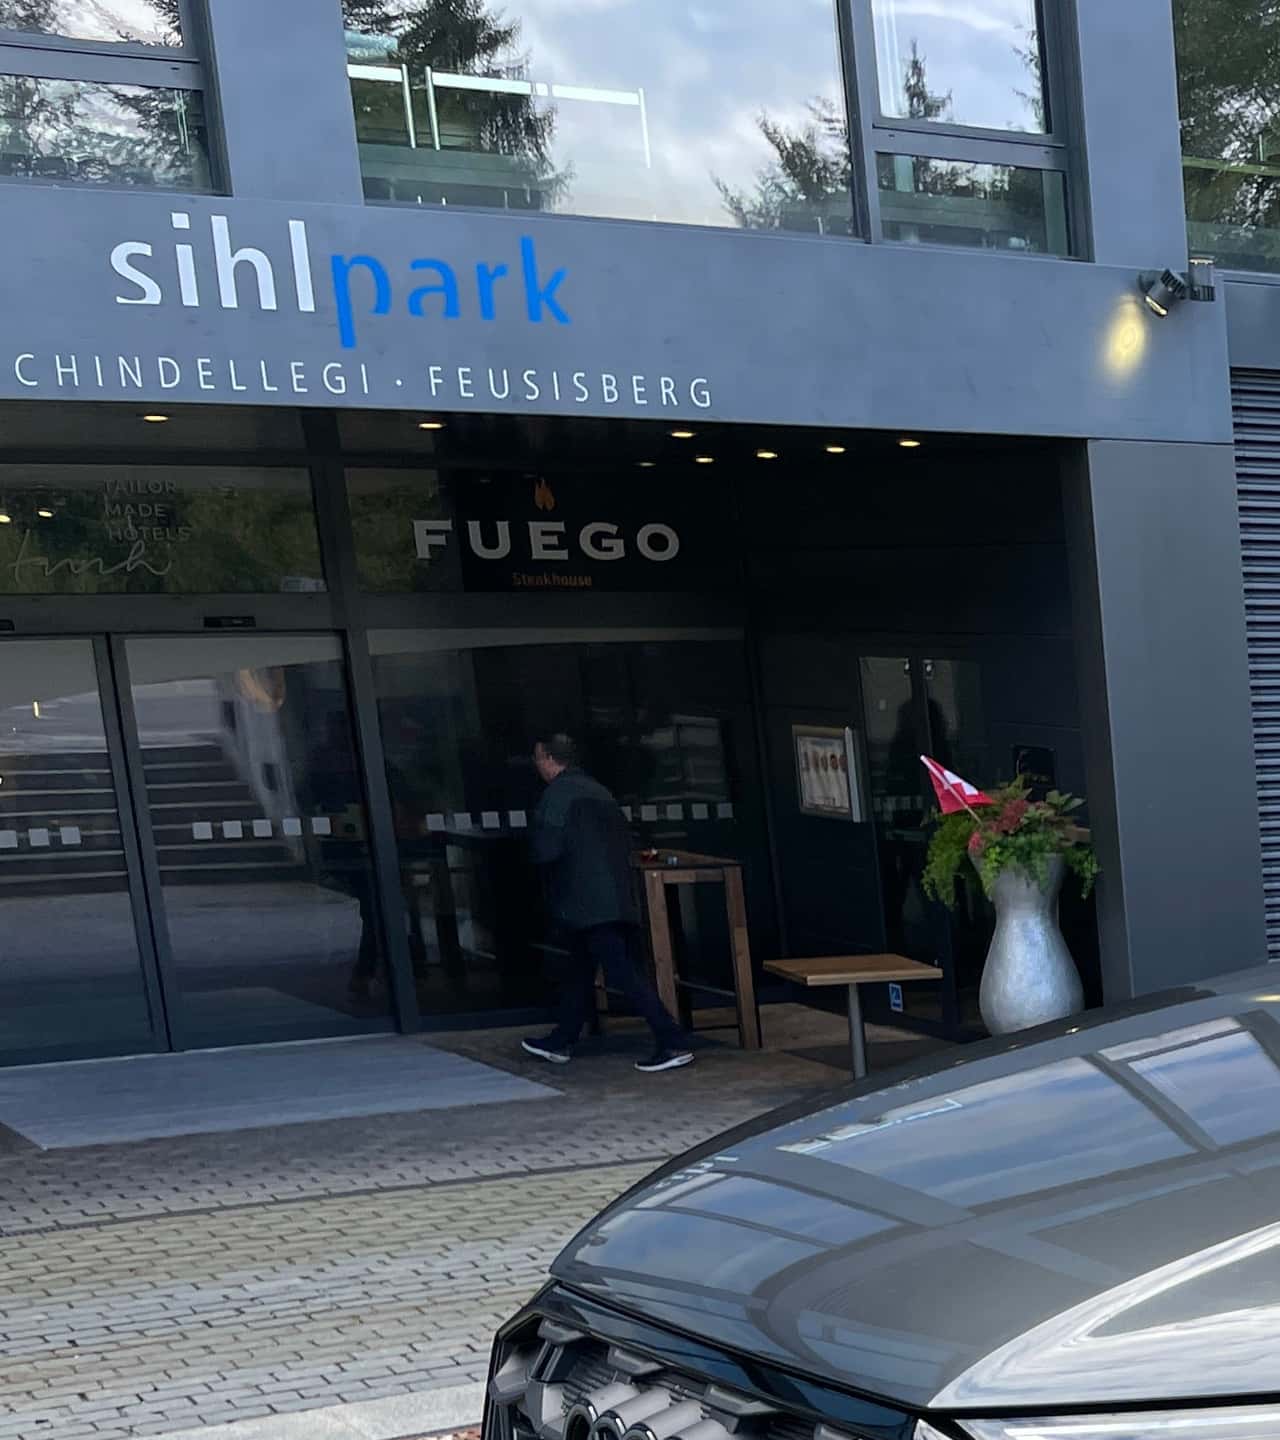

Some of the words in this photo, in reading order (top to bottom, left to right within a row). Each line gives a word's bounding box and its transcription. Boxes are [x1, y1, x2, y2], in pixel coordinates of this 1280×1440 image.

[109, 212, 572, 348] sihlpark
[429, 365, 712, 409] FEUSISBERG
[104, 478, 177, 496] TAILOR
[103, 503, 166, 519] MADE
[108, 526, 192, 542] HOTELS
[413, 519, 680, 561] FUEGO
